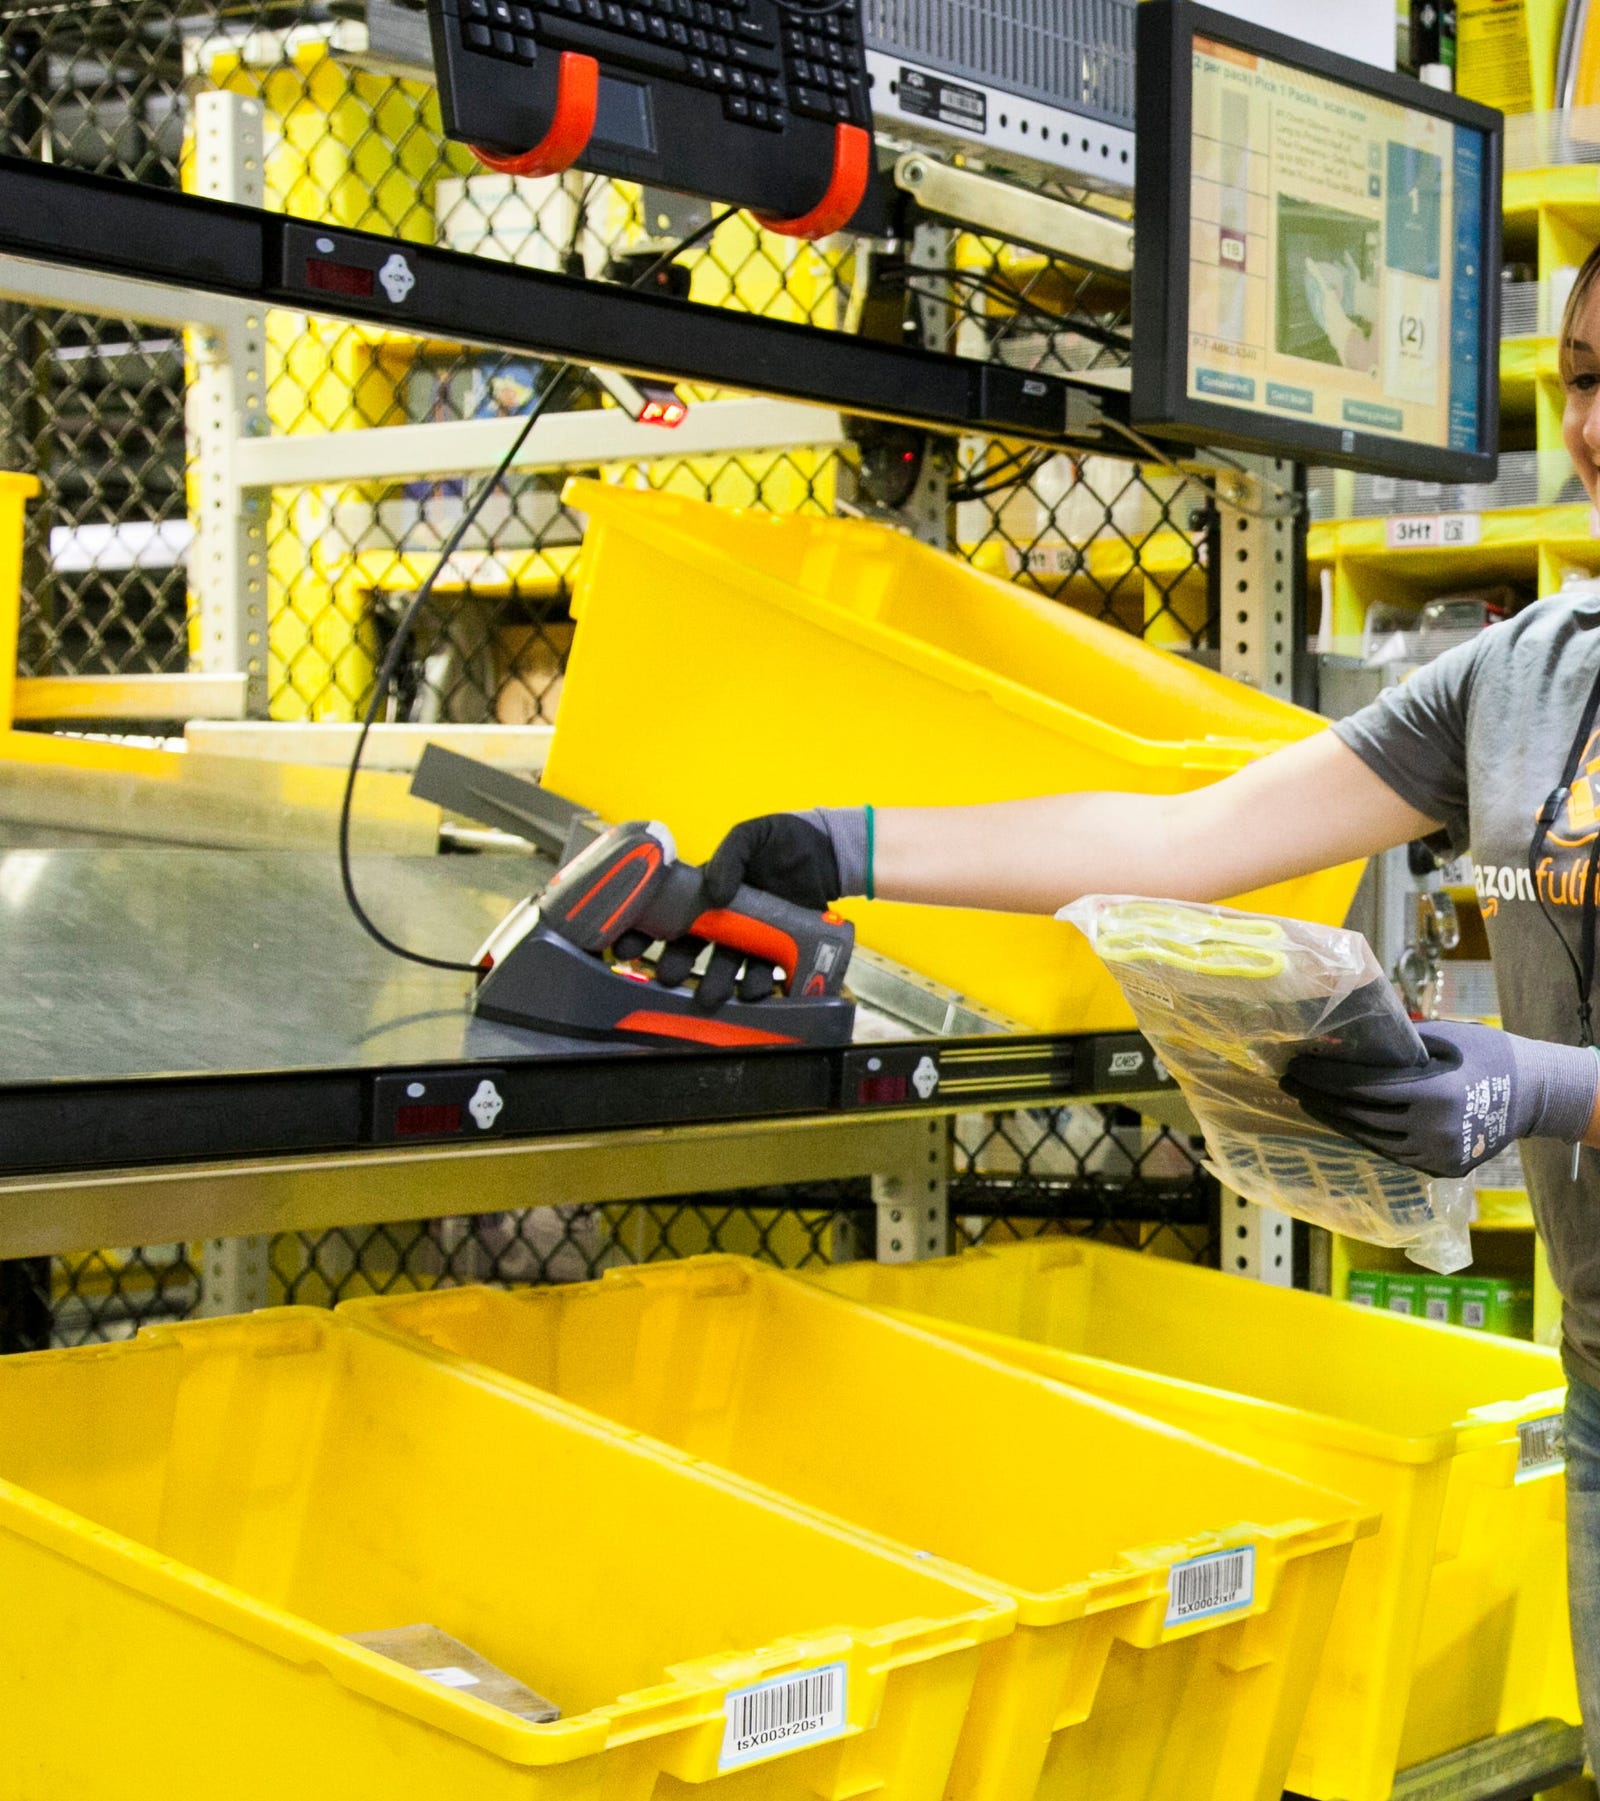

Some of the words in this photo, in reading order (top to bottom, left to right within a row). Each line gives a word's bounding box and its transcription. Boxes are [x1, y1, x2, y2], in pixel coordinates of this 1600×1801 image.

[1398, 314, 1425, 351] (2)
[1396, 522, 1422, 540] 3H
[1474, 864, 1537, 901] azon
[737, 1716, 824, 1751] tsX003r20s1
